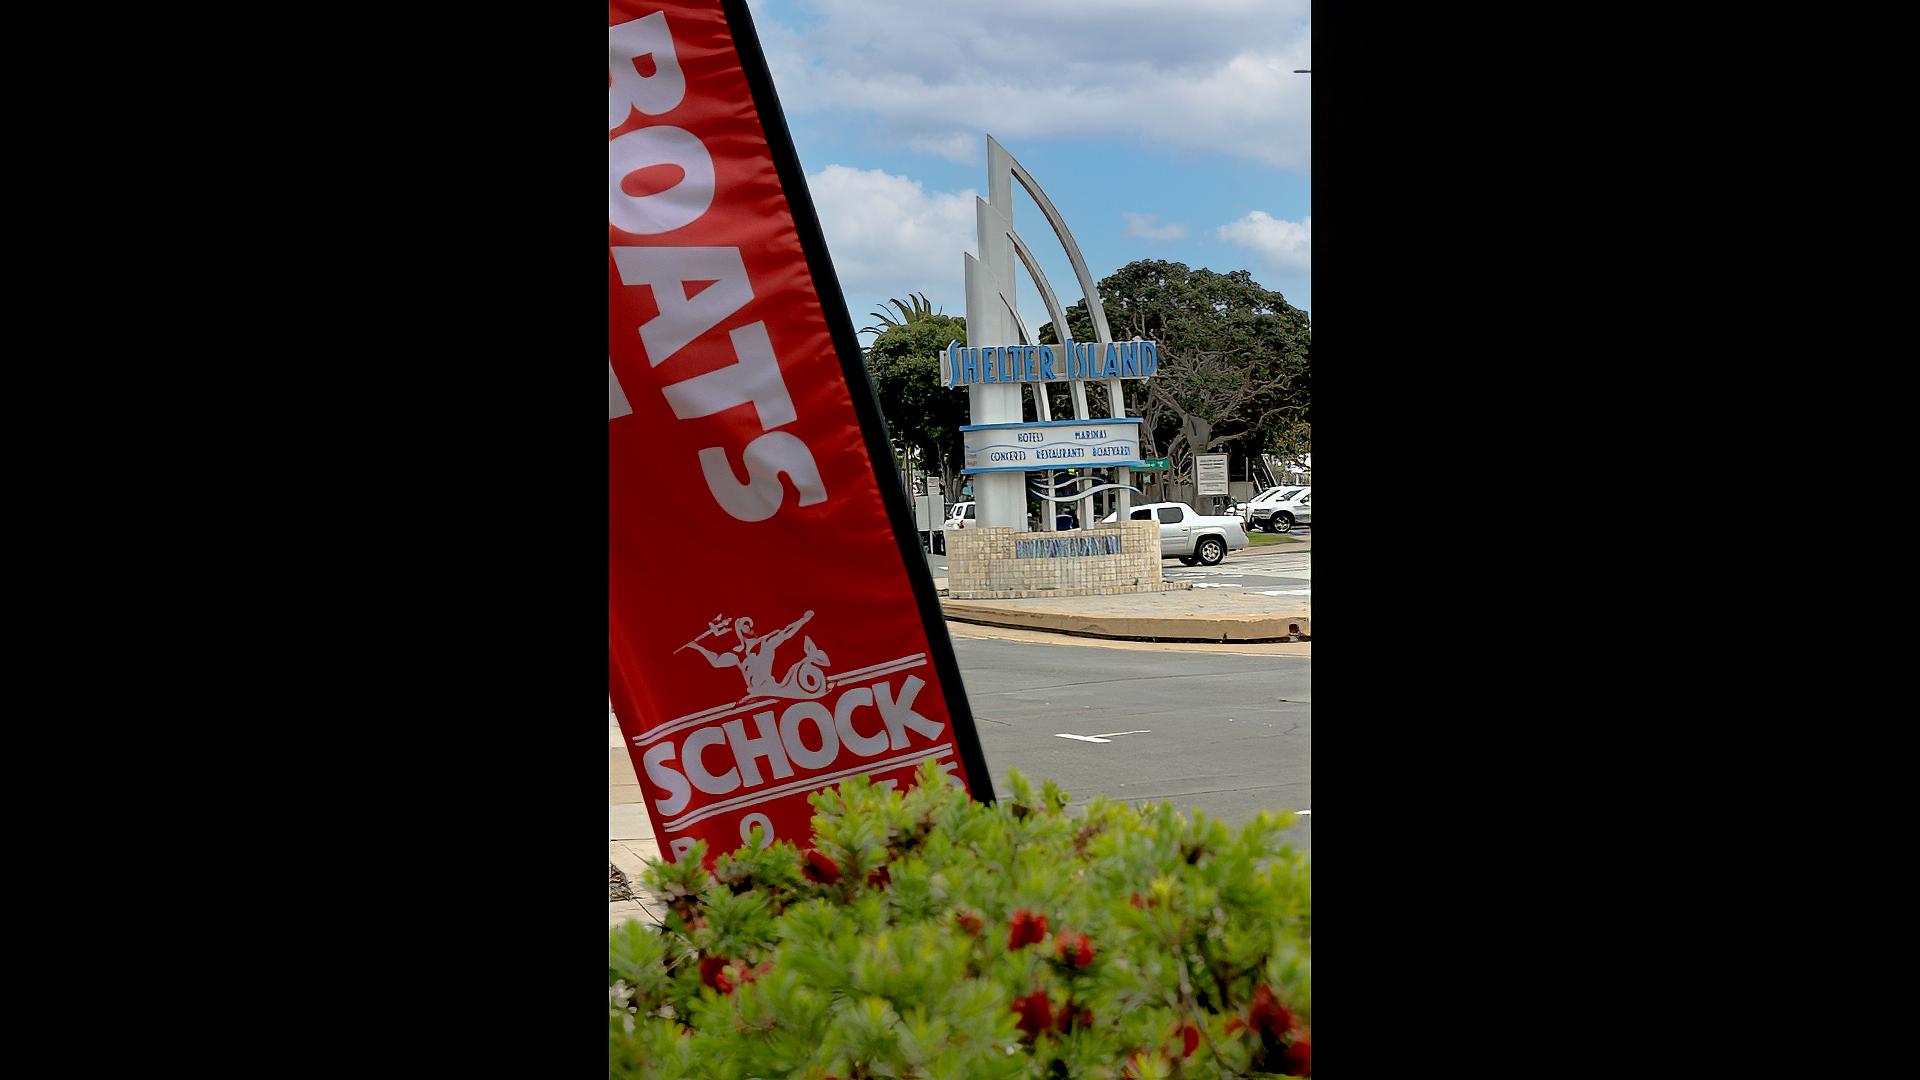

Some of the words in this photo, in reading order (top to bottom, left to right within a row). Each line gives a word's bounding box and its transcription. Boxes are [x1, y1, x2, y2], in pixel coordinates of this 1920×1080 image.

[609, 10, 828, 523] BOATS
[947, 339, 1056, 390] SHELTER
[1066, 337, 1159, 380] ISLAND
[1017, 432, 1044, 443] HOTELS
[1074, 429, 1107, 440] MARINAS
[1036, 447, 1085, 460] RESTAURANTS
[643, 675, 945, 816] SCHOCK
